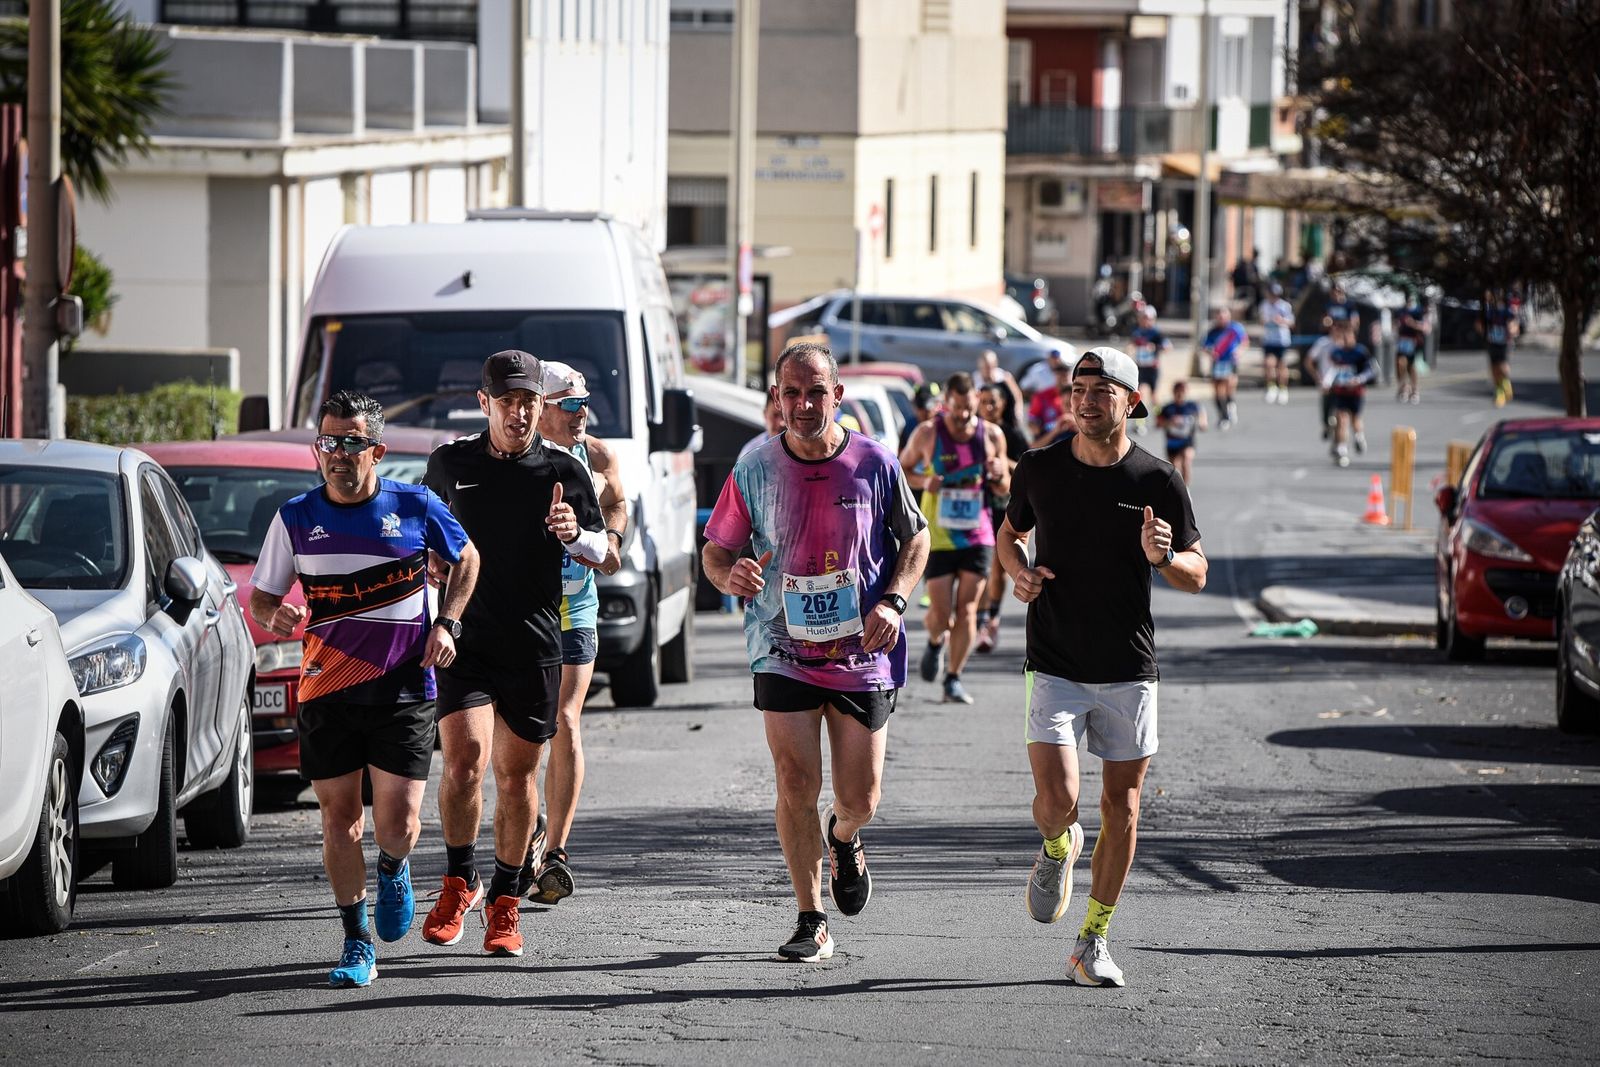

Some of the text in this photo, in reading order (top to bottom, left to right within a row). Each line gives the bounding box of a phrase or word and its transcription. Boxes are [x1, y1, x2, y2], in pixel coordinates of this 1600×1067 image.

[836, 571, 851, 584] 2K
[801, 592, 839, 614] 262
[806, 626, 839, 635] Huelva
